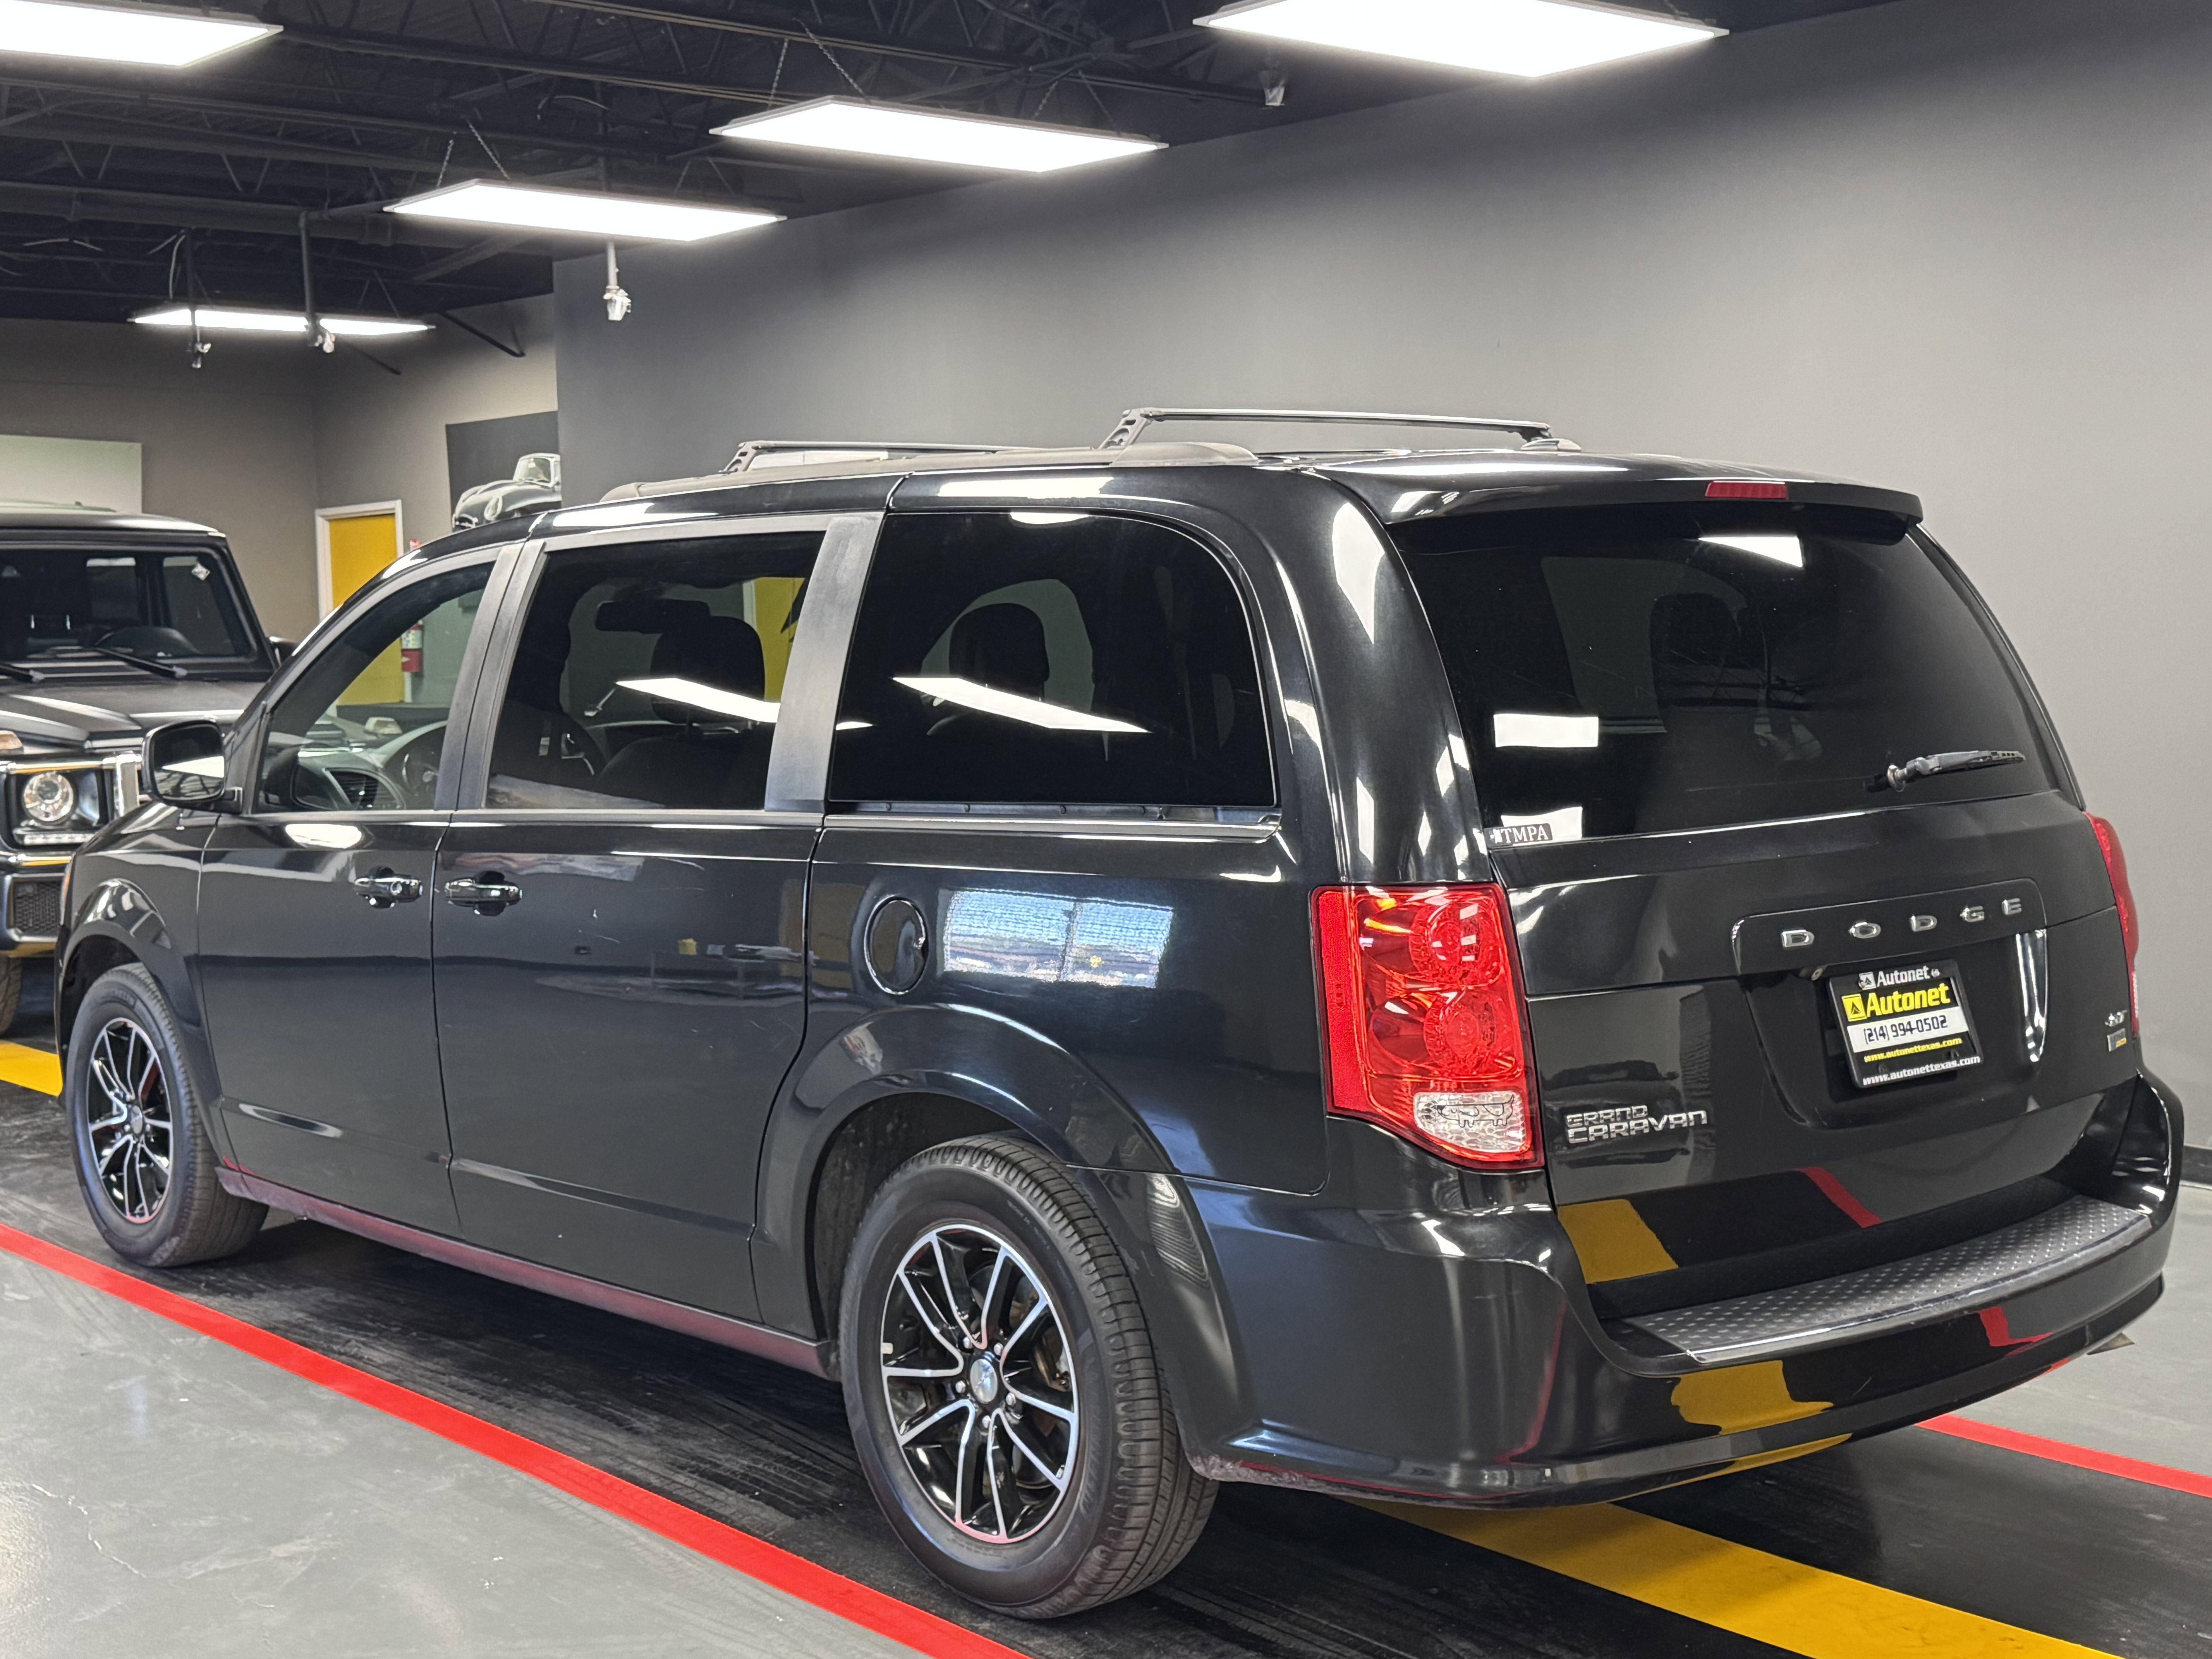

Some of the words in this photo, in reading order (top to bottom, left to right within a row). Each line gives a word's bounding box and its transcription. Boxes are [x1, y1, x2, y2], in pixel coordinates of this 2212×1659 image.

[1501, 825, 1549, 843] TMPA
[1781, 898, 2022, 948] DODGE
[1877, 965, 1930, 987] Autonet
[1867, 982, 1951, 1017] Autonet
[1863, 1025, 1889, 1045] (214)
[1890, 1015, 1948, 1038] 994-0502
[1863, 1037, 1963, 1063] www.autonettexas.com
[1863, 1056, 1981, 1085] www.autonettexas.com
[1566, 1104, 1648, 1128] GRAND
[1568, 1110, 1708, 1144] CARAVAN
